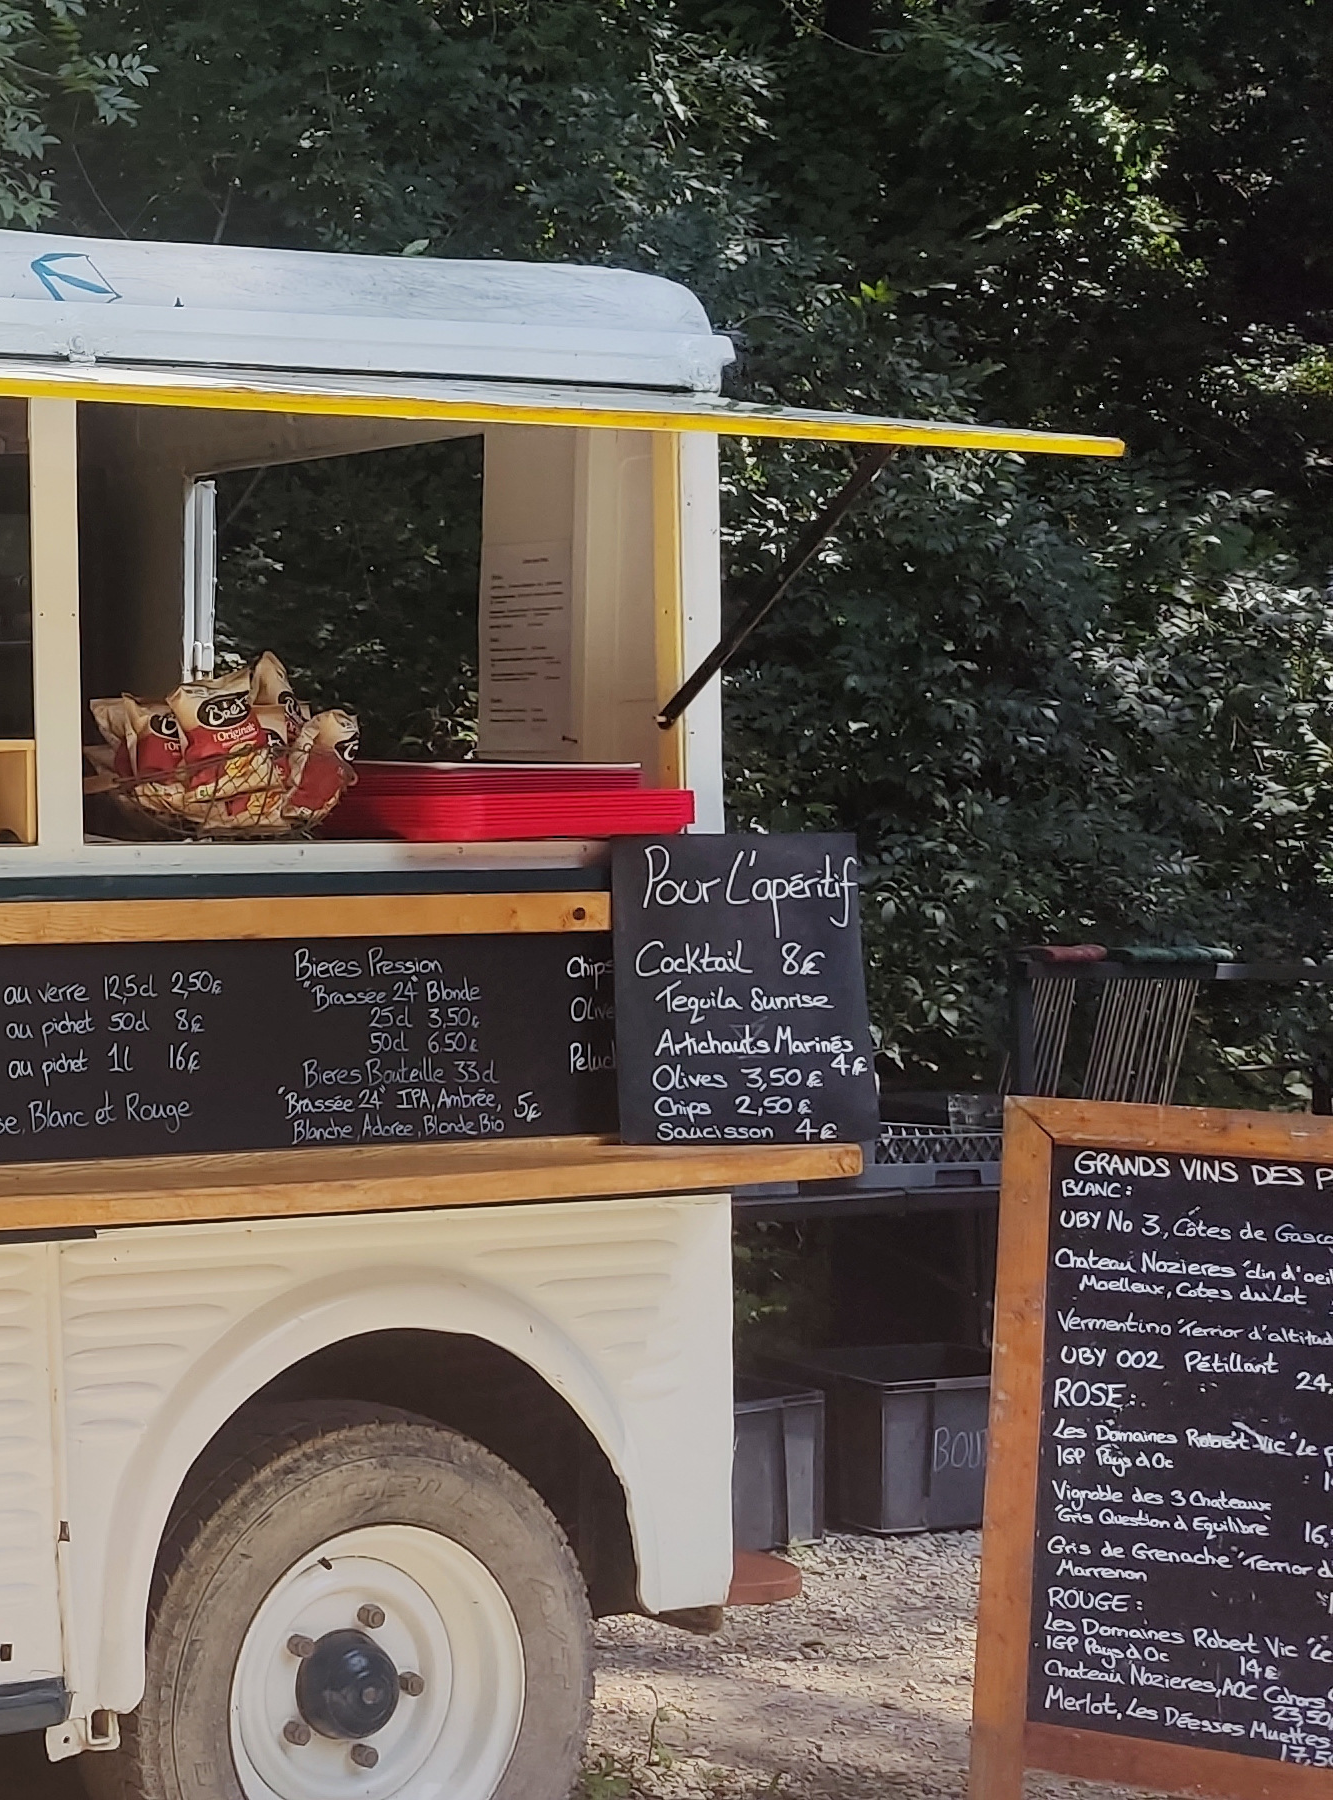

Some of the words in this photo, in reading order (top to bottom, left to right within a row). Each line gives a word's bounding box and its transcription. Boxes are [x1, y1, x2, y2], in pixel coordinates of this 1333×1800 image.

[643, 846, 721, 908] Pour
[726, 850, 857, 938] L'apéritif
[295, 948, 362, 981] Bieres
[368, 947, 442, 976] Pression
[636, 940, 753, 976] Cocktail
[782, 943, 825, 975] 8€
[4, 987, 32, 1004] au
[38, 983, 89, 1002] verre
[172, 971, 221, 999] 2,50€
[427, 977, 480, 1002] Blonde
[655, 980, 743, 1024] Tequila
[751, 988, 834, 1011] Sunrise
[6, 1023, 33, 1038] au
[42, 1010, 94, 1047] pichet
[175, 1009, 204, 1032] 8€
[369, 1006, 413, 1028] 25cl
[369, 1031, 409, 1054] 50cl
[655, 1025, 770, 1056] Artichauts
[775, 1026, 853, 1055] Marinés
[831, 1053, 867, 1075] 4€
[9, 1061, 33, 1078] au
[42, 1049, 87, 1086] pichet
[170, 1042, 199, 1073] 16€
[303, 1059, 362, 1088] Bieres
[365, 1057, 446, 1085] Bouteille
[653, 1064, 727, 1091] Olives
[741, 1068, 823, 1091] 3,50€
[28, 1100, 89, 1132] Blanc
[95, 1091, 116, 1124] et
[127, 1093, 192, 1133] Rouge
[514, 1092, 541, 1122] 5€
[654, 1097, 711, 1123] Chips
[735, 1096, 811, 1116] 2,50€
[423, 1114, 478, 1135] Blonde
[479, 1116, 504, 1133] Bio
[657, 1123, 773, 1140] Saucisson
[796, 1118, 837, 1140] 4€
[1075, 1151, 1170, 1177] GRANDS
[1180, 1159, 1238, 1182] VINS
[1251, 1165, 1304, 1185] DES
[1060, 1210, 1101, 1229] UBY
[1107, 1210, 1132, 1232] No
[1173, 1207, 1231, 1240] Côtes
[1240, 1222, 1267, 1241] de
[1055, 1248, 1136, 1273] Chateau
[1141, 1251, 1236, 1277] Nozieres
[1176, 1282, 1233, 1302] Cotes
[1273, 1285, 1307, 1304] Lot
[1058, 1308, 1171, 1335] Vermentino
[1061, 1346, 1106, 1367] UBY
[1117, 1350, 1164, 1369] 002
[1184, 1351, 1278, 1374] Pétillant
[1053, 1418, 1087, 1439] Les
[1096, 1424, 1178, 1444] Domaines
[1185, 1429, 1252, 1450] Robert
[1057, 1445, 1085, 1467] IGP
[1096, 1444, 1132, 1477] Pays
[1153, 1453, 1174, 1468] Oc
[1052, 1480, 1123, 1511] Vignoble
[1132, 1487, 1164, 1504] des
[1171, 1490, 1186, 1506] 3
[1189, 1491, 1271, 1511] Chateaux
[1099, 1509, 1170, 1528] Question
[1048, 1536, 1091, 1555] Gris
[1101, 1541, 1125, 1558] de
[1132, 1543, 1233, 1568] Grenache
[1056, 1559, 1147, 1581] Marrenon
[1044, 1611, 1076, 1632] Les
[1082, 1619, 1185, 1644] Domaines
[1193, 1628, 1260, 1653] Robert
[1264, 1637, 1298, 1657] Vic
[1047, 1635, 1079, 1652] IGP
[1085, 1637, 1124, 1669] Pays
[1144, 1647, 1169, 1661] Oc
[1045, 1660, 1125, 1684] Chateau
[1222, 1678, 1257, 1700] AOC
[1263, 1686, 1326, 1709] Cahors
[1126, 1698, 1158, 1720] Les
[1165, 1707, 1245, 1736] Déesses
[1250, 1721, 1330, 1749] Muettes
